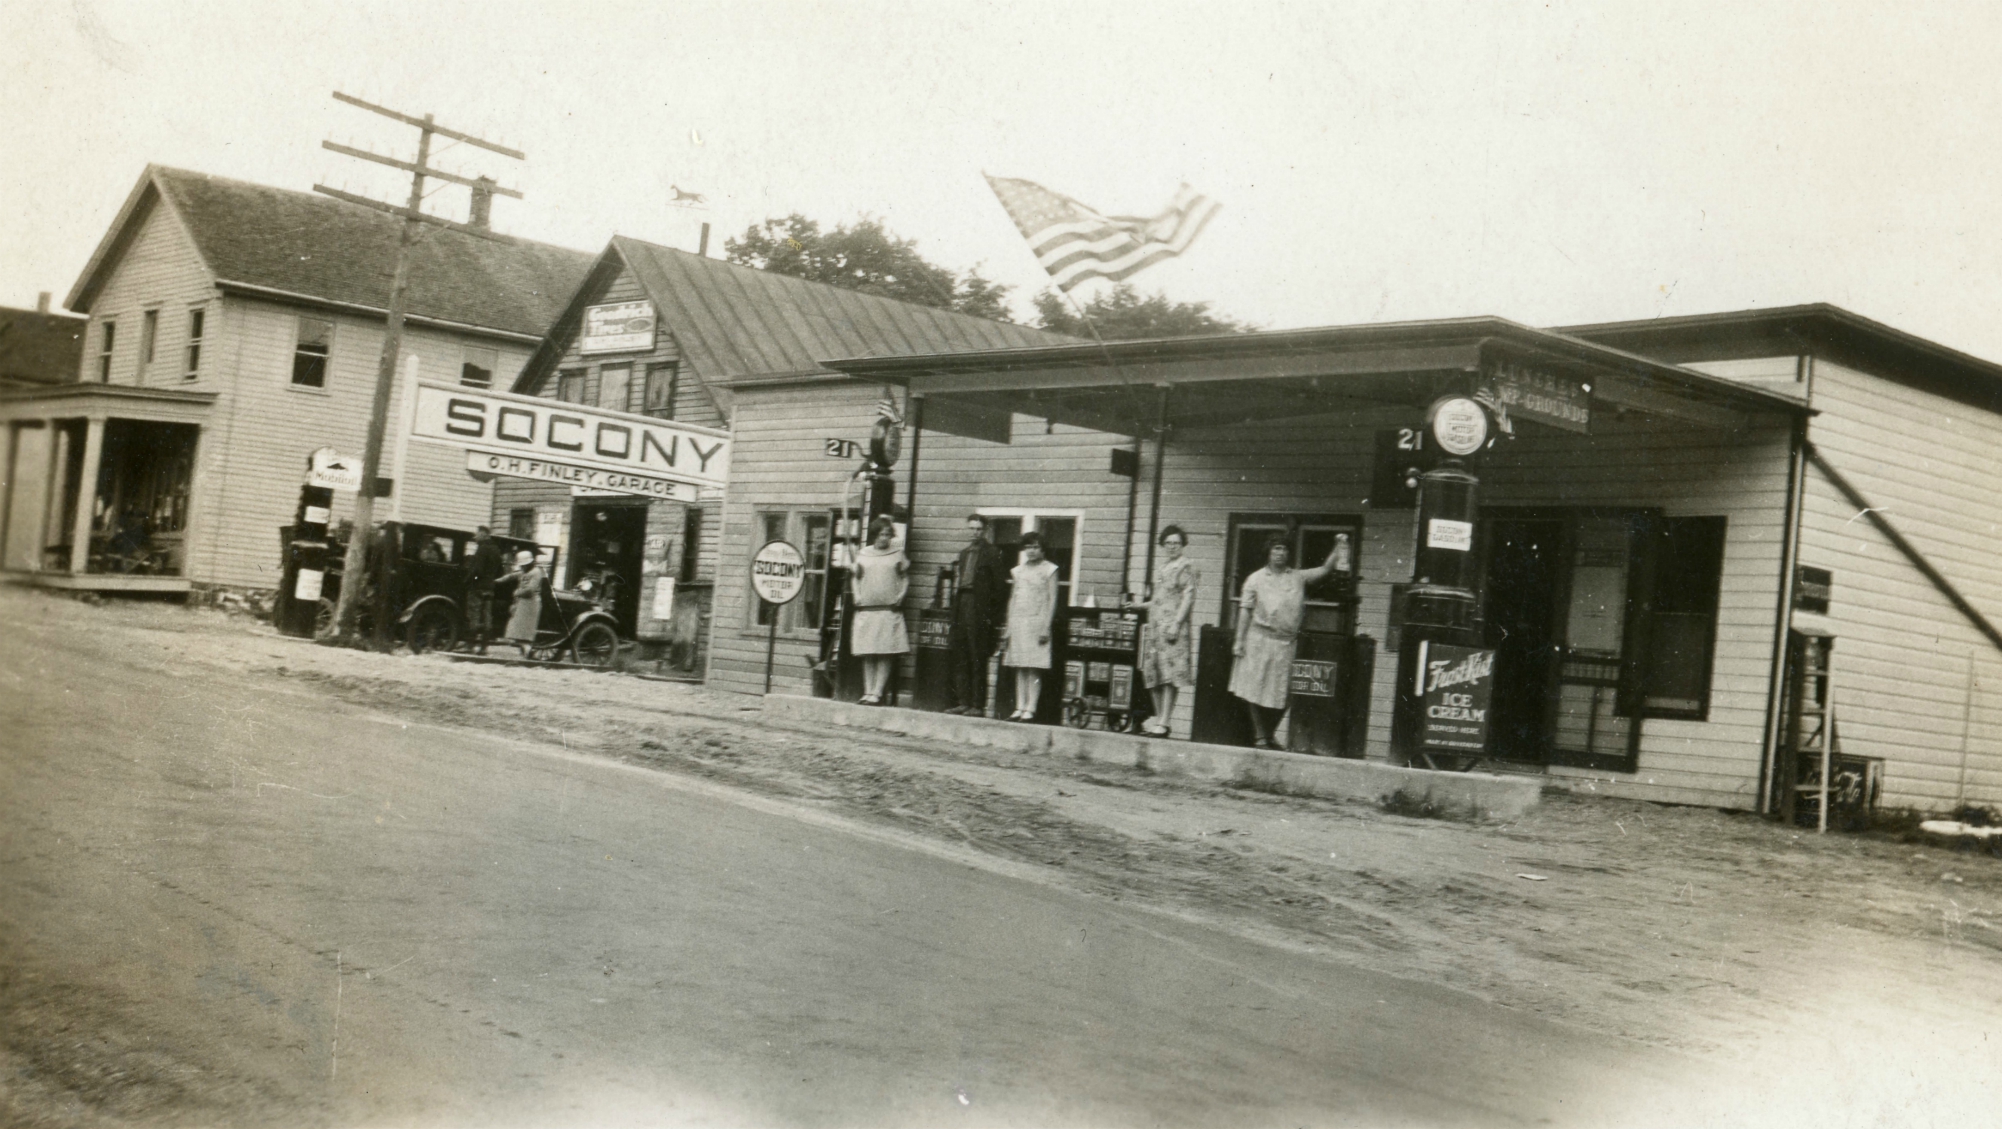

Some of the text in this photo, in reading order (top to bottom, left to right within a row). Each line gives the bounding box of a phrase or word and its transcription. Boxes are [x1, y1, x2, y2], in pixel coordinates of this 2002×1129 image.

[446, 397, 723, 473] SOCONY
[1397, 428, 1423, 450] 21
[826, 439, 850, 457] 21
[607, 474, 677, 496] GARAGE
[754, 560, 804, 578] SOCONY
[761, 579, 793, 590] MOTOR
[770, 589, 784, 599] OIL
[1441, 692, 1473, 708] ICE
[1426, 705, 1486, 722] CREAM
